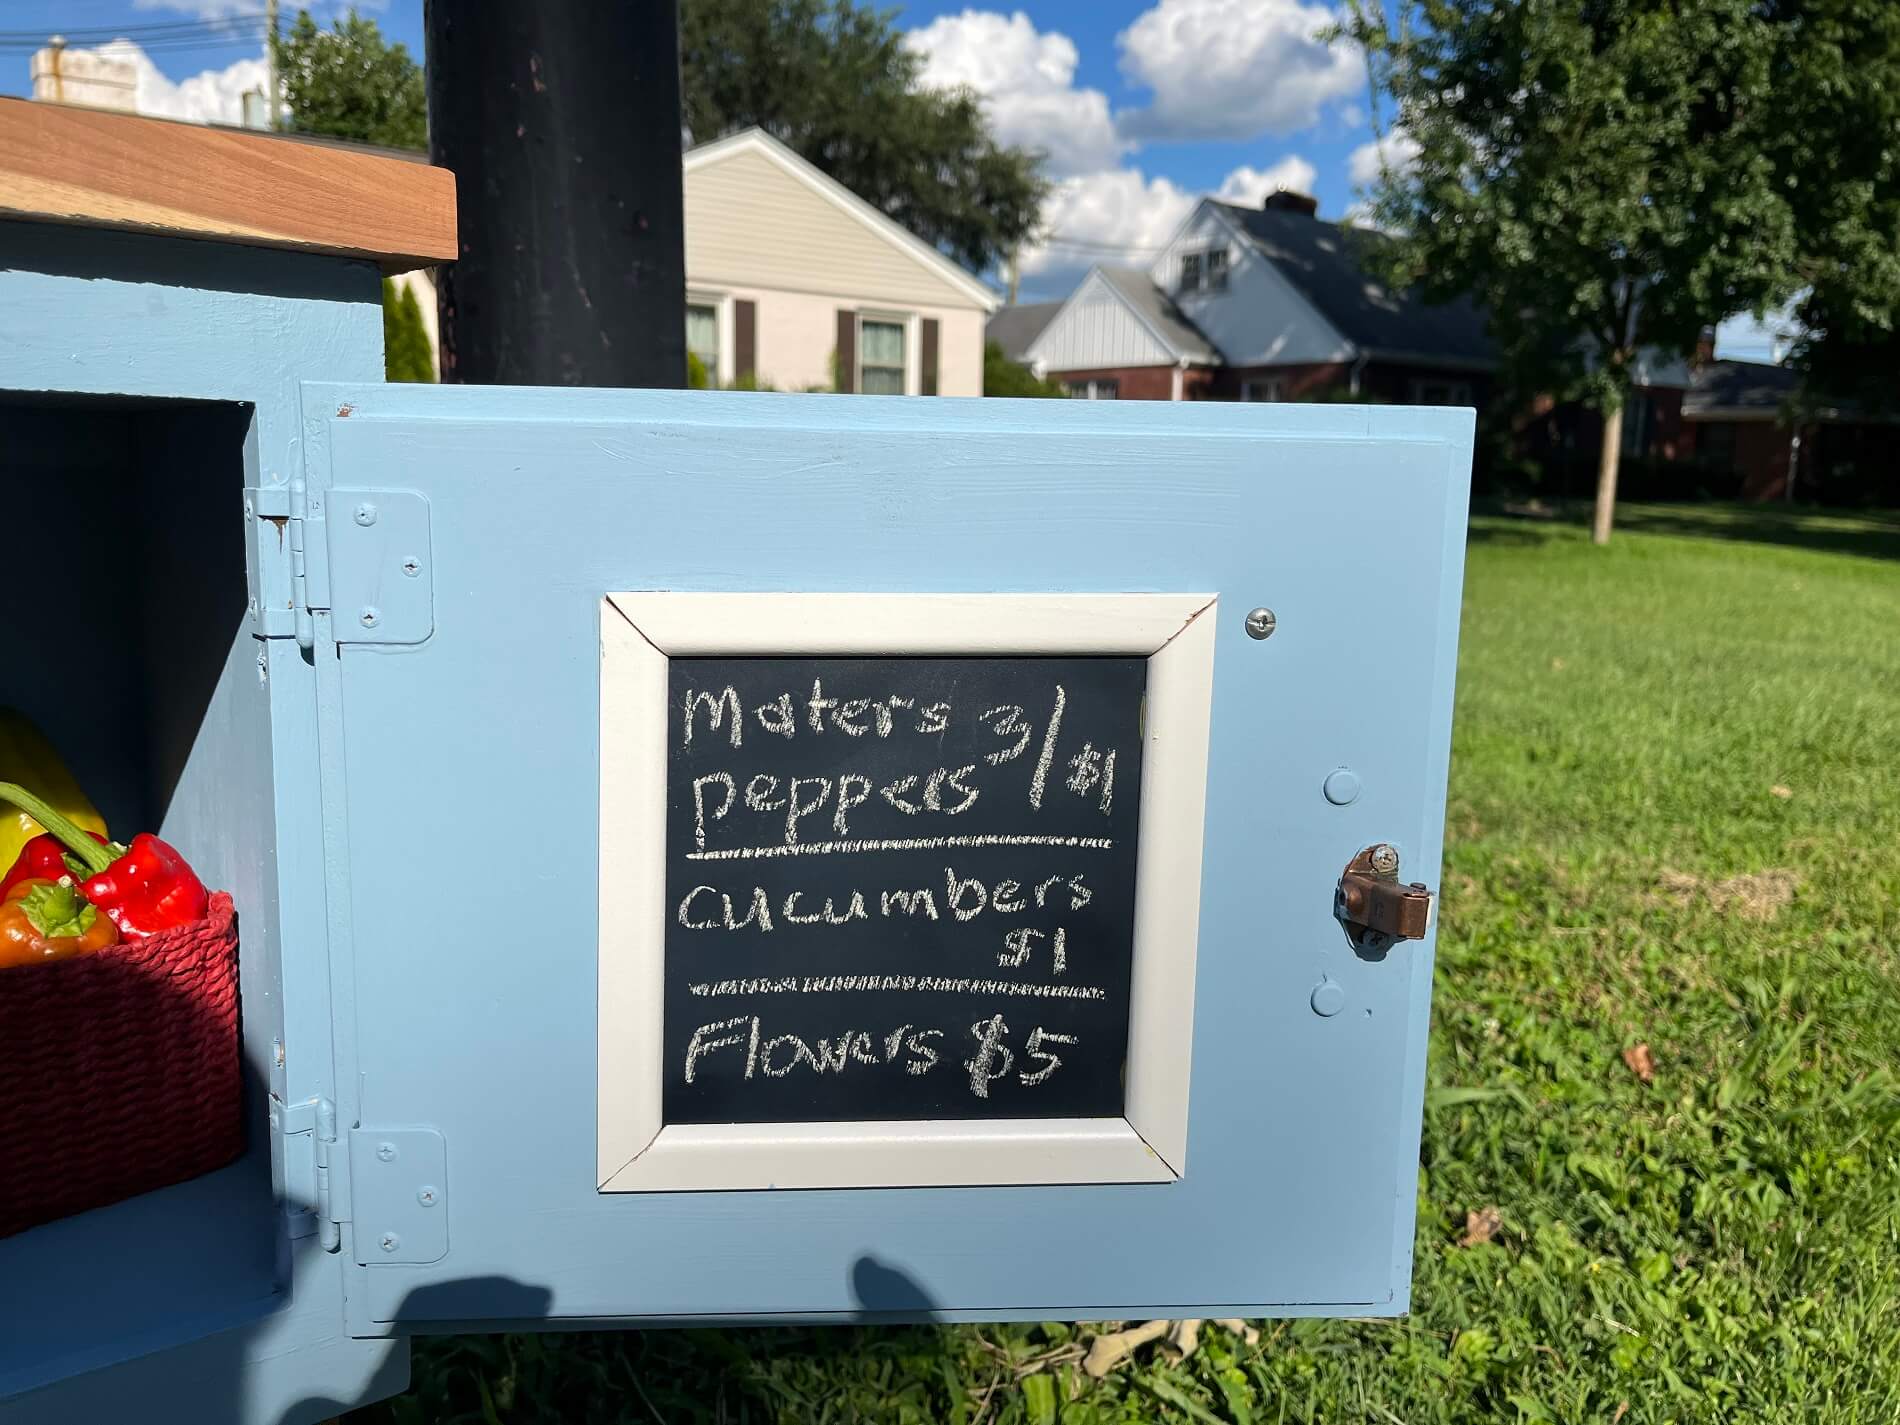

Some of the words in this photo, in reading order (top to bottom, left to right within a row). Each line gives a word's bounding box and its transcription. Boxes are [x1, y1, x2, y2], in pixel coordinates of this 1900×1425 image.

[997, 926, 1067, 976] $1
[685, 1015, 944, 1083] Flowers
[964, 1013, 1079, 1098] $5
